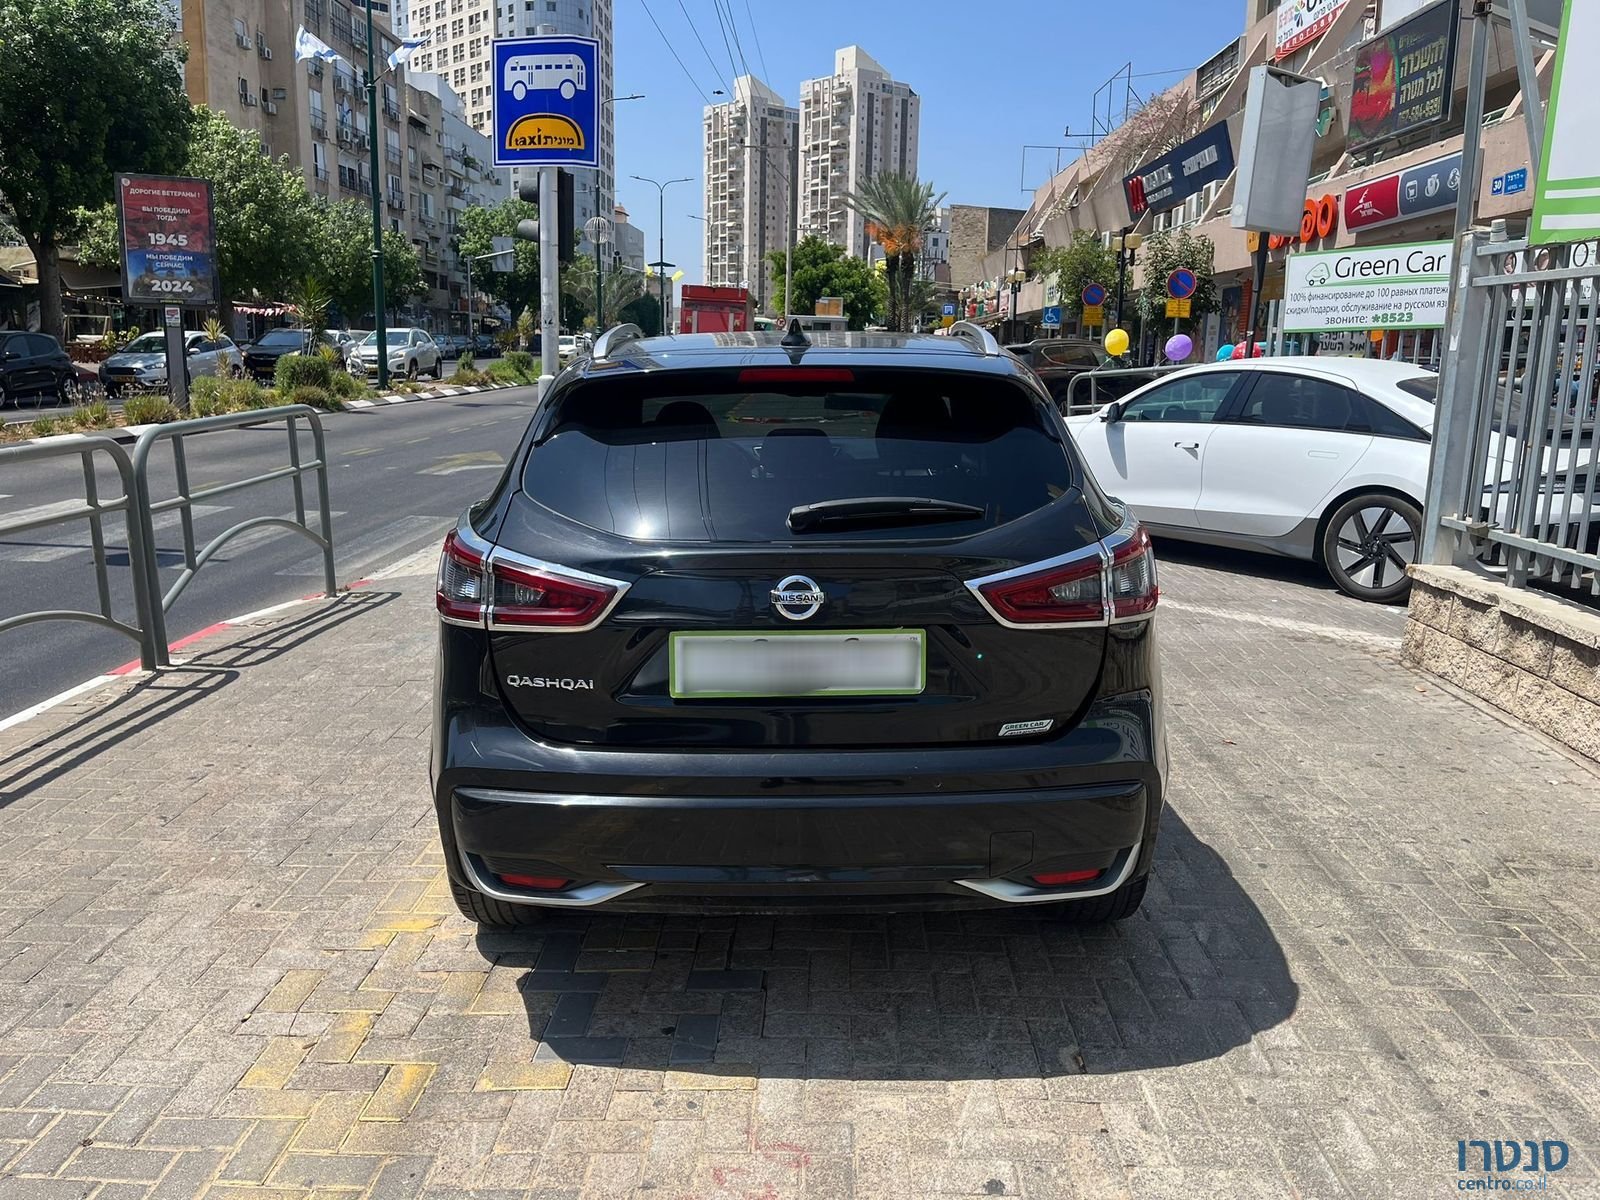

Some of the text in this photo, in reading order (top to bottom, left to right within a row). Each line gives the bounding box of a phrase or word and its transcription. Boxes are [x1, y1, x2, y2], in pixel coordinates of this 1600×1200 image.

[1400, 35, 1447, 79] להשכרה
[1400, 65, 1444, 105] לכל מטרה
[515, 127, 575, 146] taxi מונית
[129, 187, 161, 196] ДОРОГИЕ
[161, 190, 197, 198] ВЕТЕРАНЫ
[1493, 180, 1502, 191] 30
[153, 206, 191, 215] ПОБЕДИЛИ
[156, 214, 178, 222] ТОГДА
[148, 232, 189, 247] 1945
[155, 261, 185, 269] СЕЙЧАС!
[159, 254, 194, 262] ПОБЕДИМ
[1335, 251, 1447, 279] Green Car
[151, 279, 194, 293] 2024
[1290, 286, 1449, 303] 100% финансирование до 100 равных платеж
[1341, 302, 1392, 314] обслуживание
[1393, 302, 1402, 311] на
[1404, 300, 1436, 311] русском
[1437, 300, 1447, 308] яз
[1325, 315, 1368, 325] звоните:
[776, 594, 819, 602] NISSAN
[506, 674, 594, 691] QASHQAI
